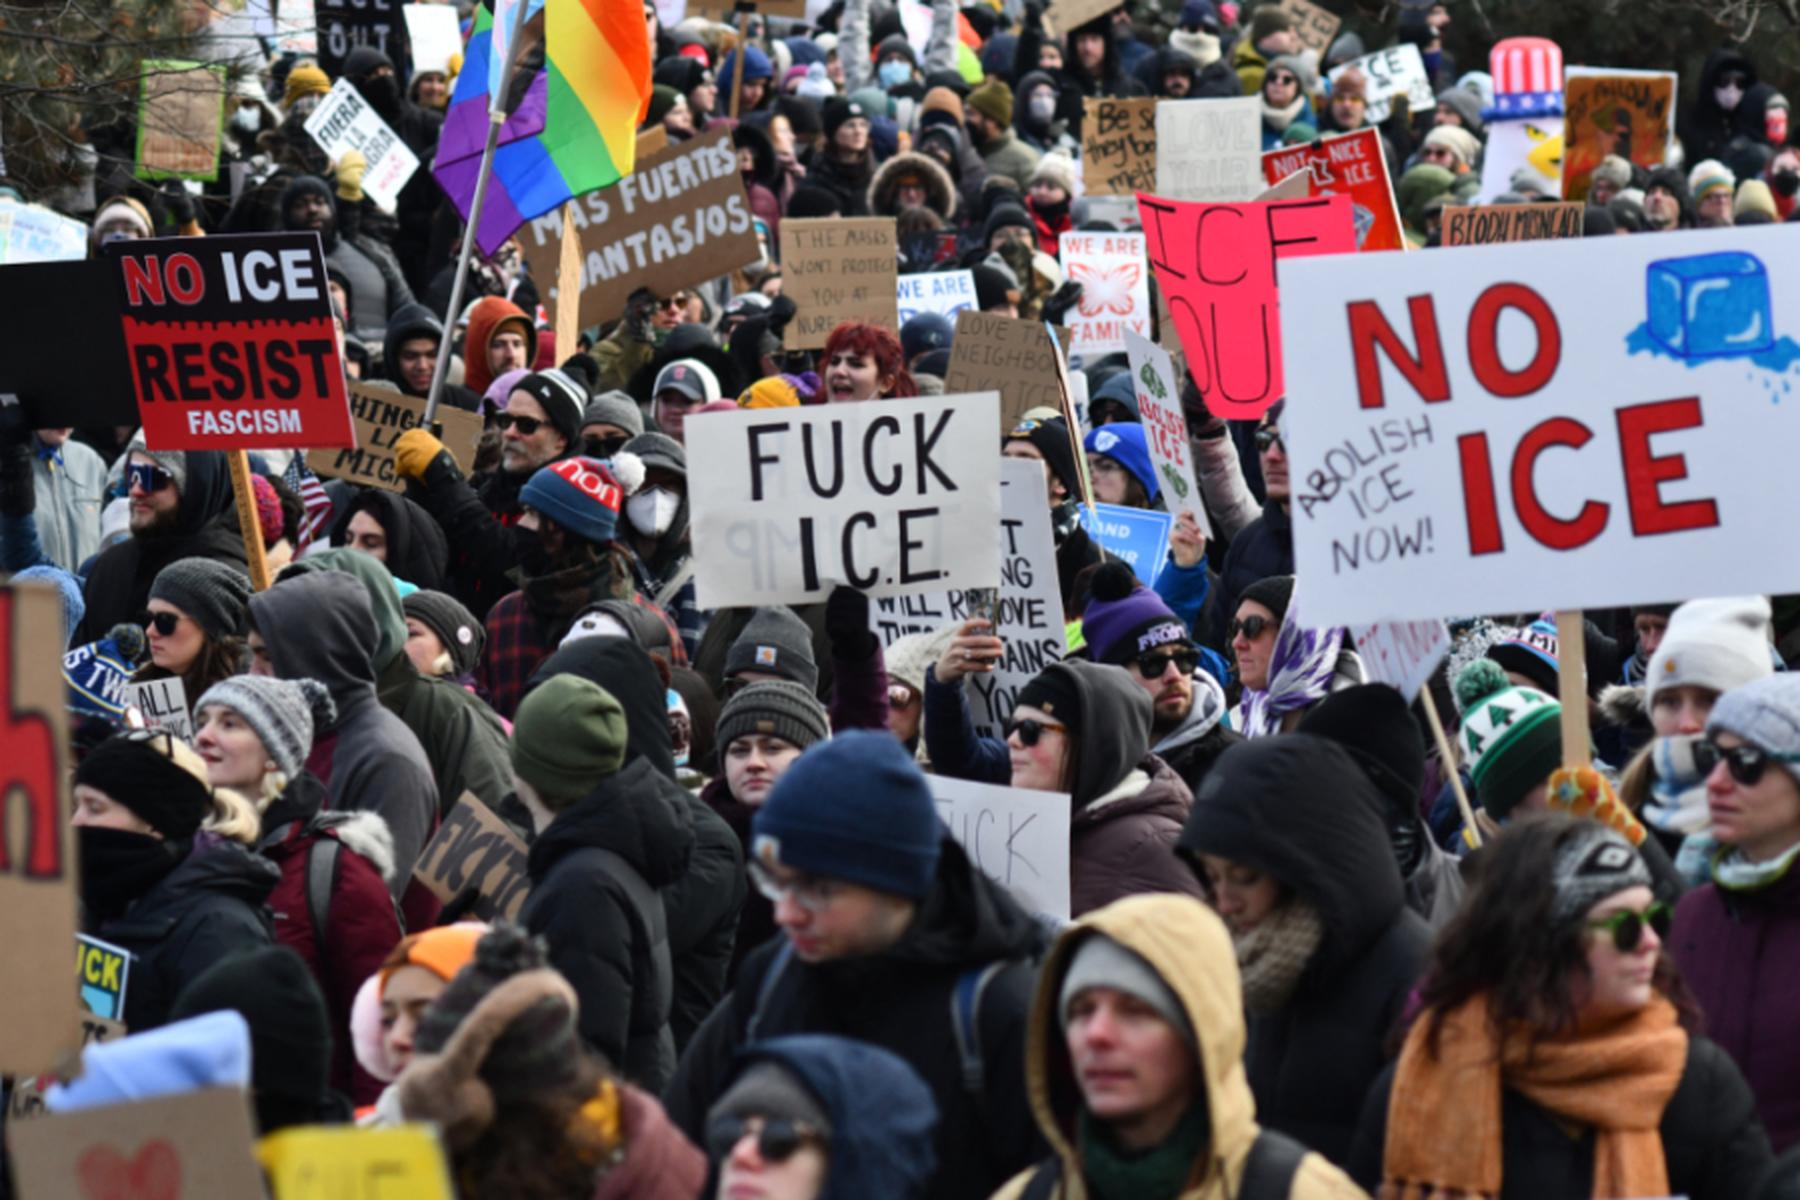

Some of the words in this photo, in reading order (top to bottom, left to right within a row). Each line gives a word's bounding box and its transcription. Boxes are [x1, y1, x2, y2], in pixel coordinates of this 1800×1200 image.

[1098, 102, 1130, 135] Be
[1328, 138, 1366, 163] NICE
[618, 136, 737, 214] FUERTES
[1065, 237, 1096, 255] WE
[1103, 236, 1139, 255] ARE
[120, 251, 206, 307] NO
[220, 248, 320, 303] ICE
[811, 286, 845, 307] YOU
[897, 279, 924, 299] WE
[932, 275, 969, 297] ARE
[958, 314, 1009, 341] LOVE
[1345, 280, 1563, 411] NO
[953, 341, 1055, 373] NEIGHBO
[1168, 294, 1272, 404] OU
[133, 338, 333, 402] RESIST
[186, 407, 304, 436] FASCISM
[746, 408, 959, 502] FUCK
[1151, 424, 1185, 467] ICE
[1297, 412, 1435, 520] ABOLISH
[333, 447, 403, 487] MIG
[1456, 395, 1722, 558] ICE
[1347, 462, 1415, 520] ICE
[1331, 515, 1436, 575] NOW!
[877, 593, 943, 618] WILL
[138, 682, 184, 717] ALL
